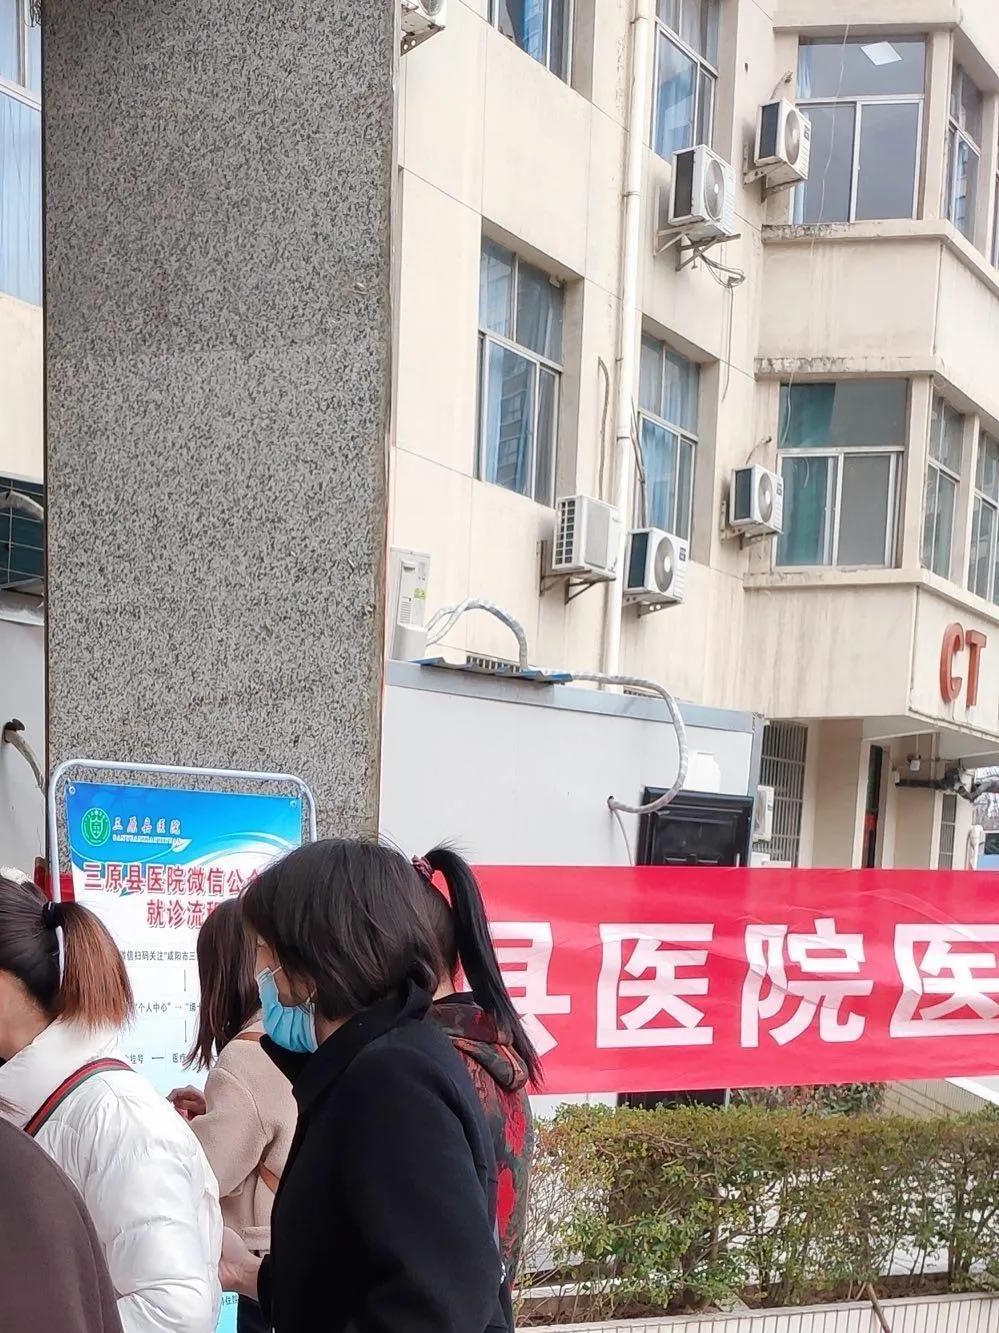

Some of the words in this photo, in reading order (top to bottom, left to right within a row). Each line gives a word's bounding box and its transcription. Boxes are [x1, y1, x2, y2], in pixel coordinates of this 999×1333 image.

[940, 622, 988, 708] CT
[462, 917, 999, 1056] 县医院医
